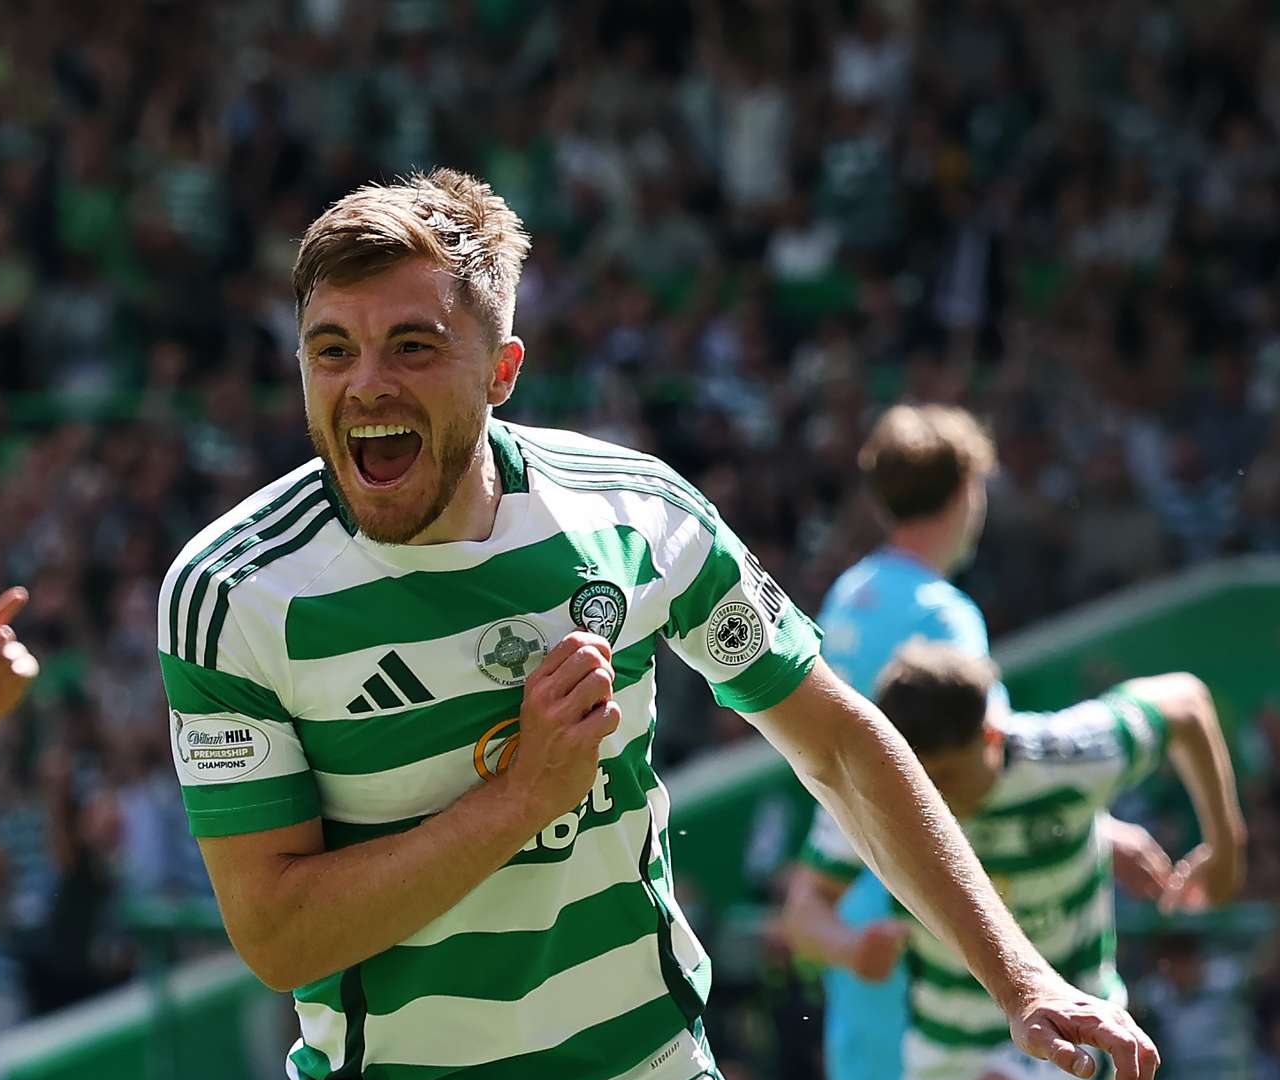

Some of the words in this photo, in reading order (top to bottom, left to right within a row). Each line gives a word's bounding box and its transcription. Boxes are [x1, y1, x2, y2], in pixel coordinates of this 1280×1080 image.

[573, 589, 592, 613] CELTIC
[590, 585, 623, 607] FOOTBALL
[721, 652, 751, 663] FOOTBALL
[187, 730, 224, 745] William
[225, 729, 253, 744] HILL
[194, 747, 249, 759] PREMIERSHIP
[197, 760, 246, 770] CHAMPIONS
